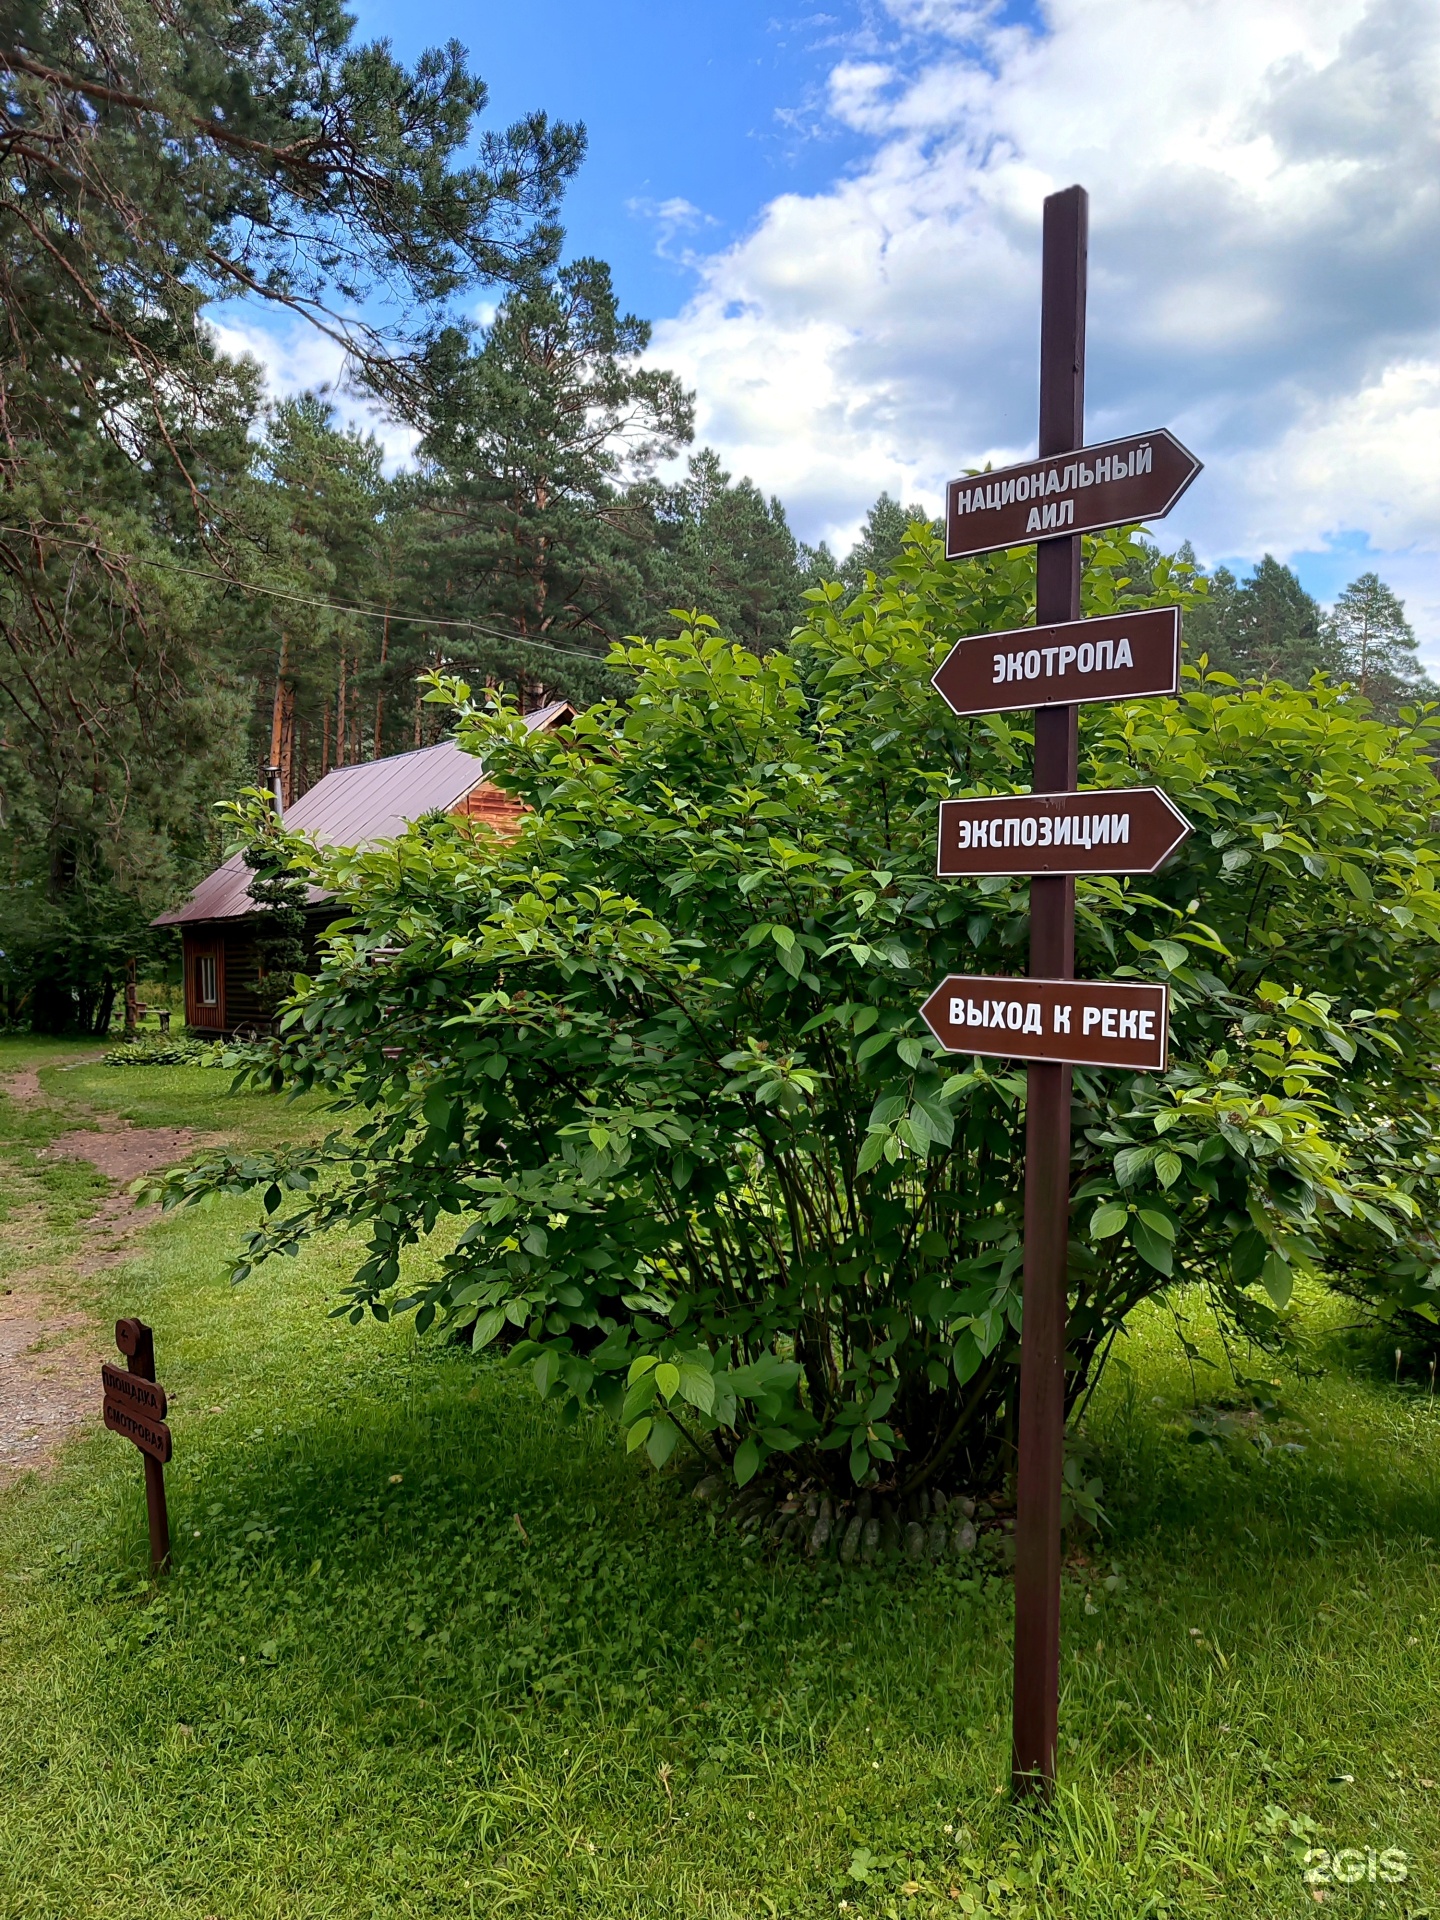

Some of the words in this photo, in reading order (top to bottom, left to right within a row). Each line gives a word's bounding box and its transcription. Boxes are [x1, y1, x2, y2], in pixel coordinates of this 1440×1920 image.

[957, 443, 1152, 515] НАЦИОНАЛЬНЫЙ
[1026, 499, 1074, 532] АИЛ
[992, 638, 1134, 684] ЭКОТРОПА
[958, 814, 1130, 850] ЭКСПОЗИЦИИ
[949, 997, 1043, 1035] ВЫХОД
[1053, 1004, 1072, 1034] К
[1082, 1006, 1156, 1041] РЕКЕ
[103, 1371, 158, 1410] ПЛОЩАДКА
[106, 1405, 164, 1452] СМОТРОВАЯ
